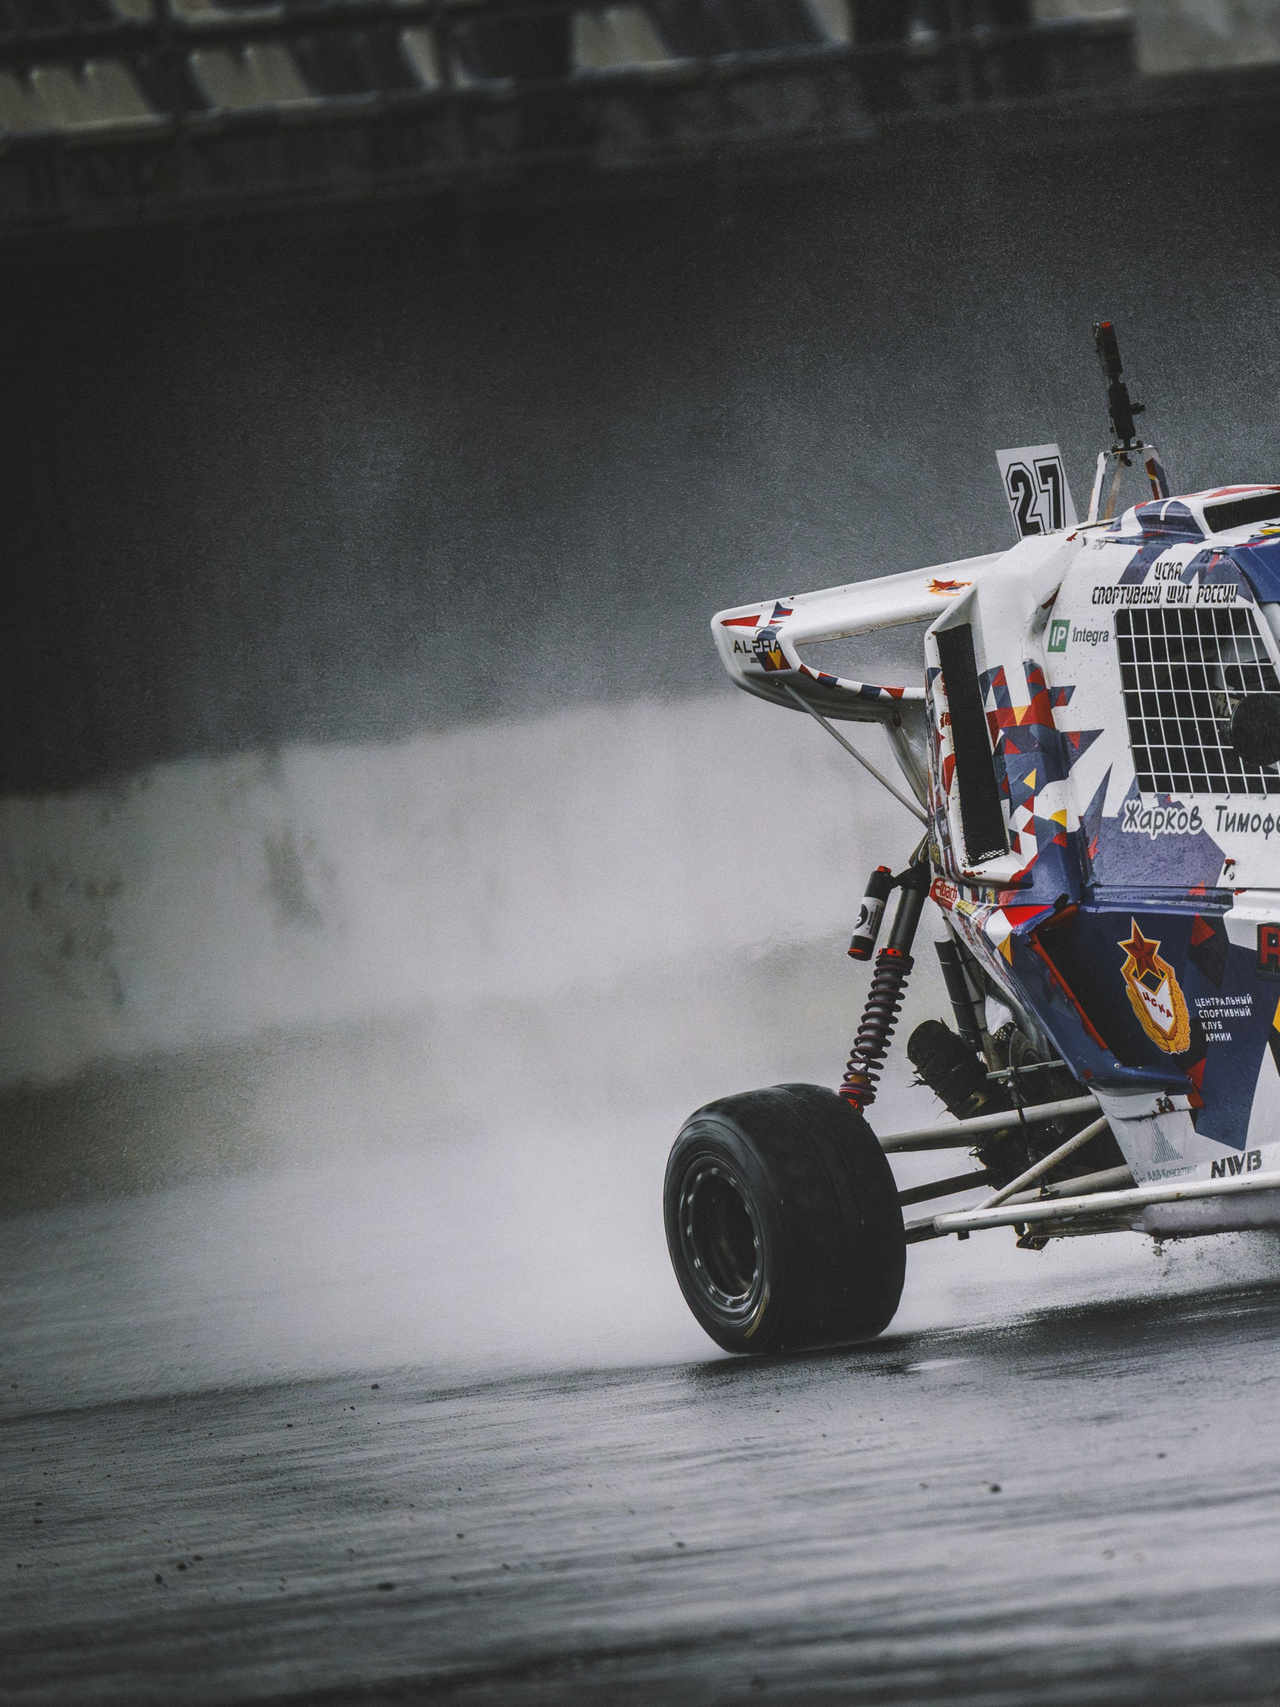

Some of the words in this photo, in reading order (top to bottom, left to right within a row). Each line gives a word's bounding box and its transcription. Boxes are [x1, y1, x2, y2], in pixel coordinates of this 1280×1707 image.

[1006, 456, 1066, 541] 27
[1154, 562, 1182, 580] ЦСКА
[1092, 583, 1162, 604] СПОРТИВНЫЙ
[1196, 585, 1239, 604] РОССИИ
[1051, 626, 1067, 647] IP
[1072, 627, 1109, 647] Integra
[733, 640, 782, 653] ALPHA
[1123, 802, 1203, 838] Жарков
[1142, 991, 1173, 1018] ЦСКА
[1195, 994, 1253, 1007] ЦЕНТРАЛЬНЫЙ
[1198, 1006, 1251, 1018] СПОРТИВНЫЙ
[1201, 1021, 1223, 1030] КЛУБ
[1205, 1033, 1232, 1042] АРМИИ
[1211, 1149, 1262, 1179] NWB
